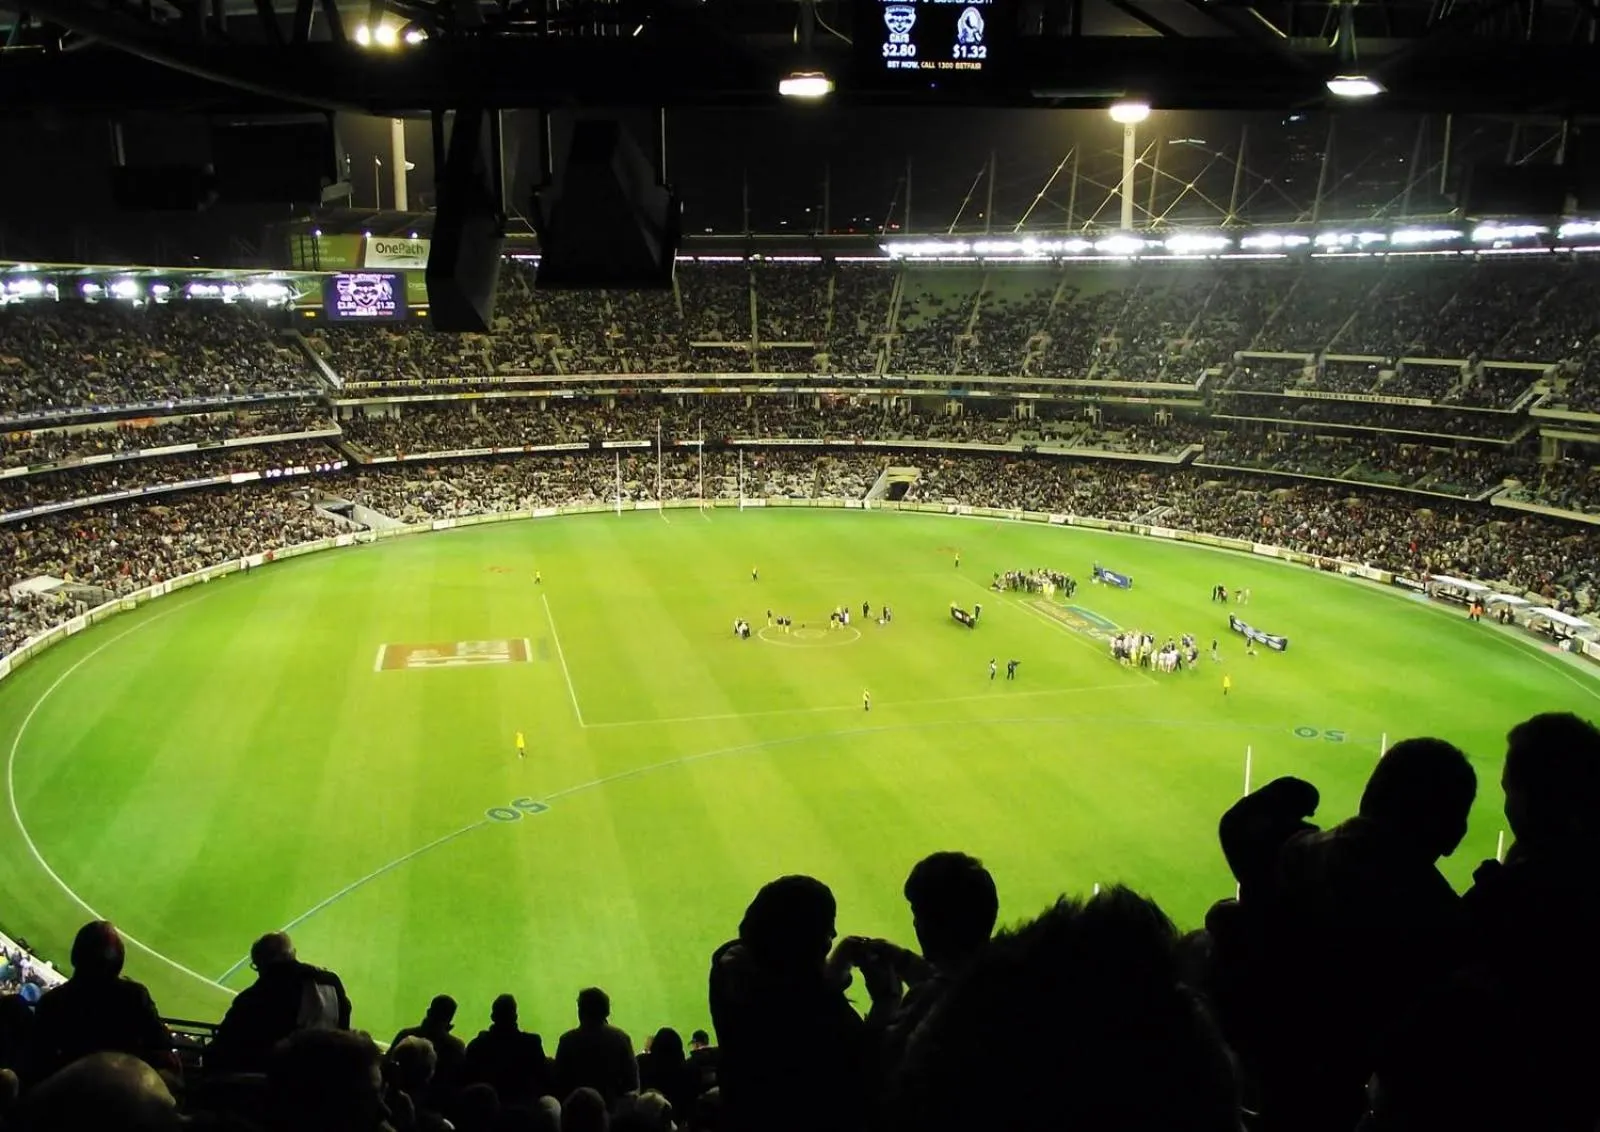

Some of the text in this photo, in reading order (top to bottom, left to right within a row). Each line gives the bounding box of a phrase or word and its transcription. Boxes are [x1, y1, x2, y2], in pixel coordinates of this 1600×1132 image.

[882, 42, 916, 57] $2.80
[953, 43, 987, 59] $1.32
[920, 61, 936, 69] CALL
[375, 242, 424, 254] OnePath
